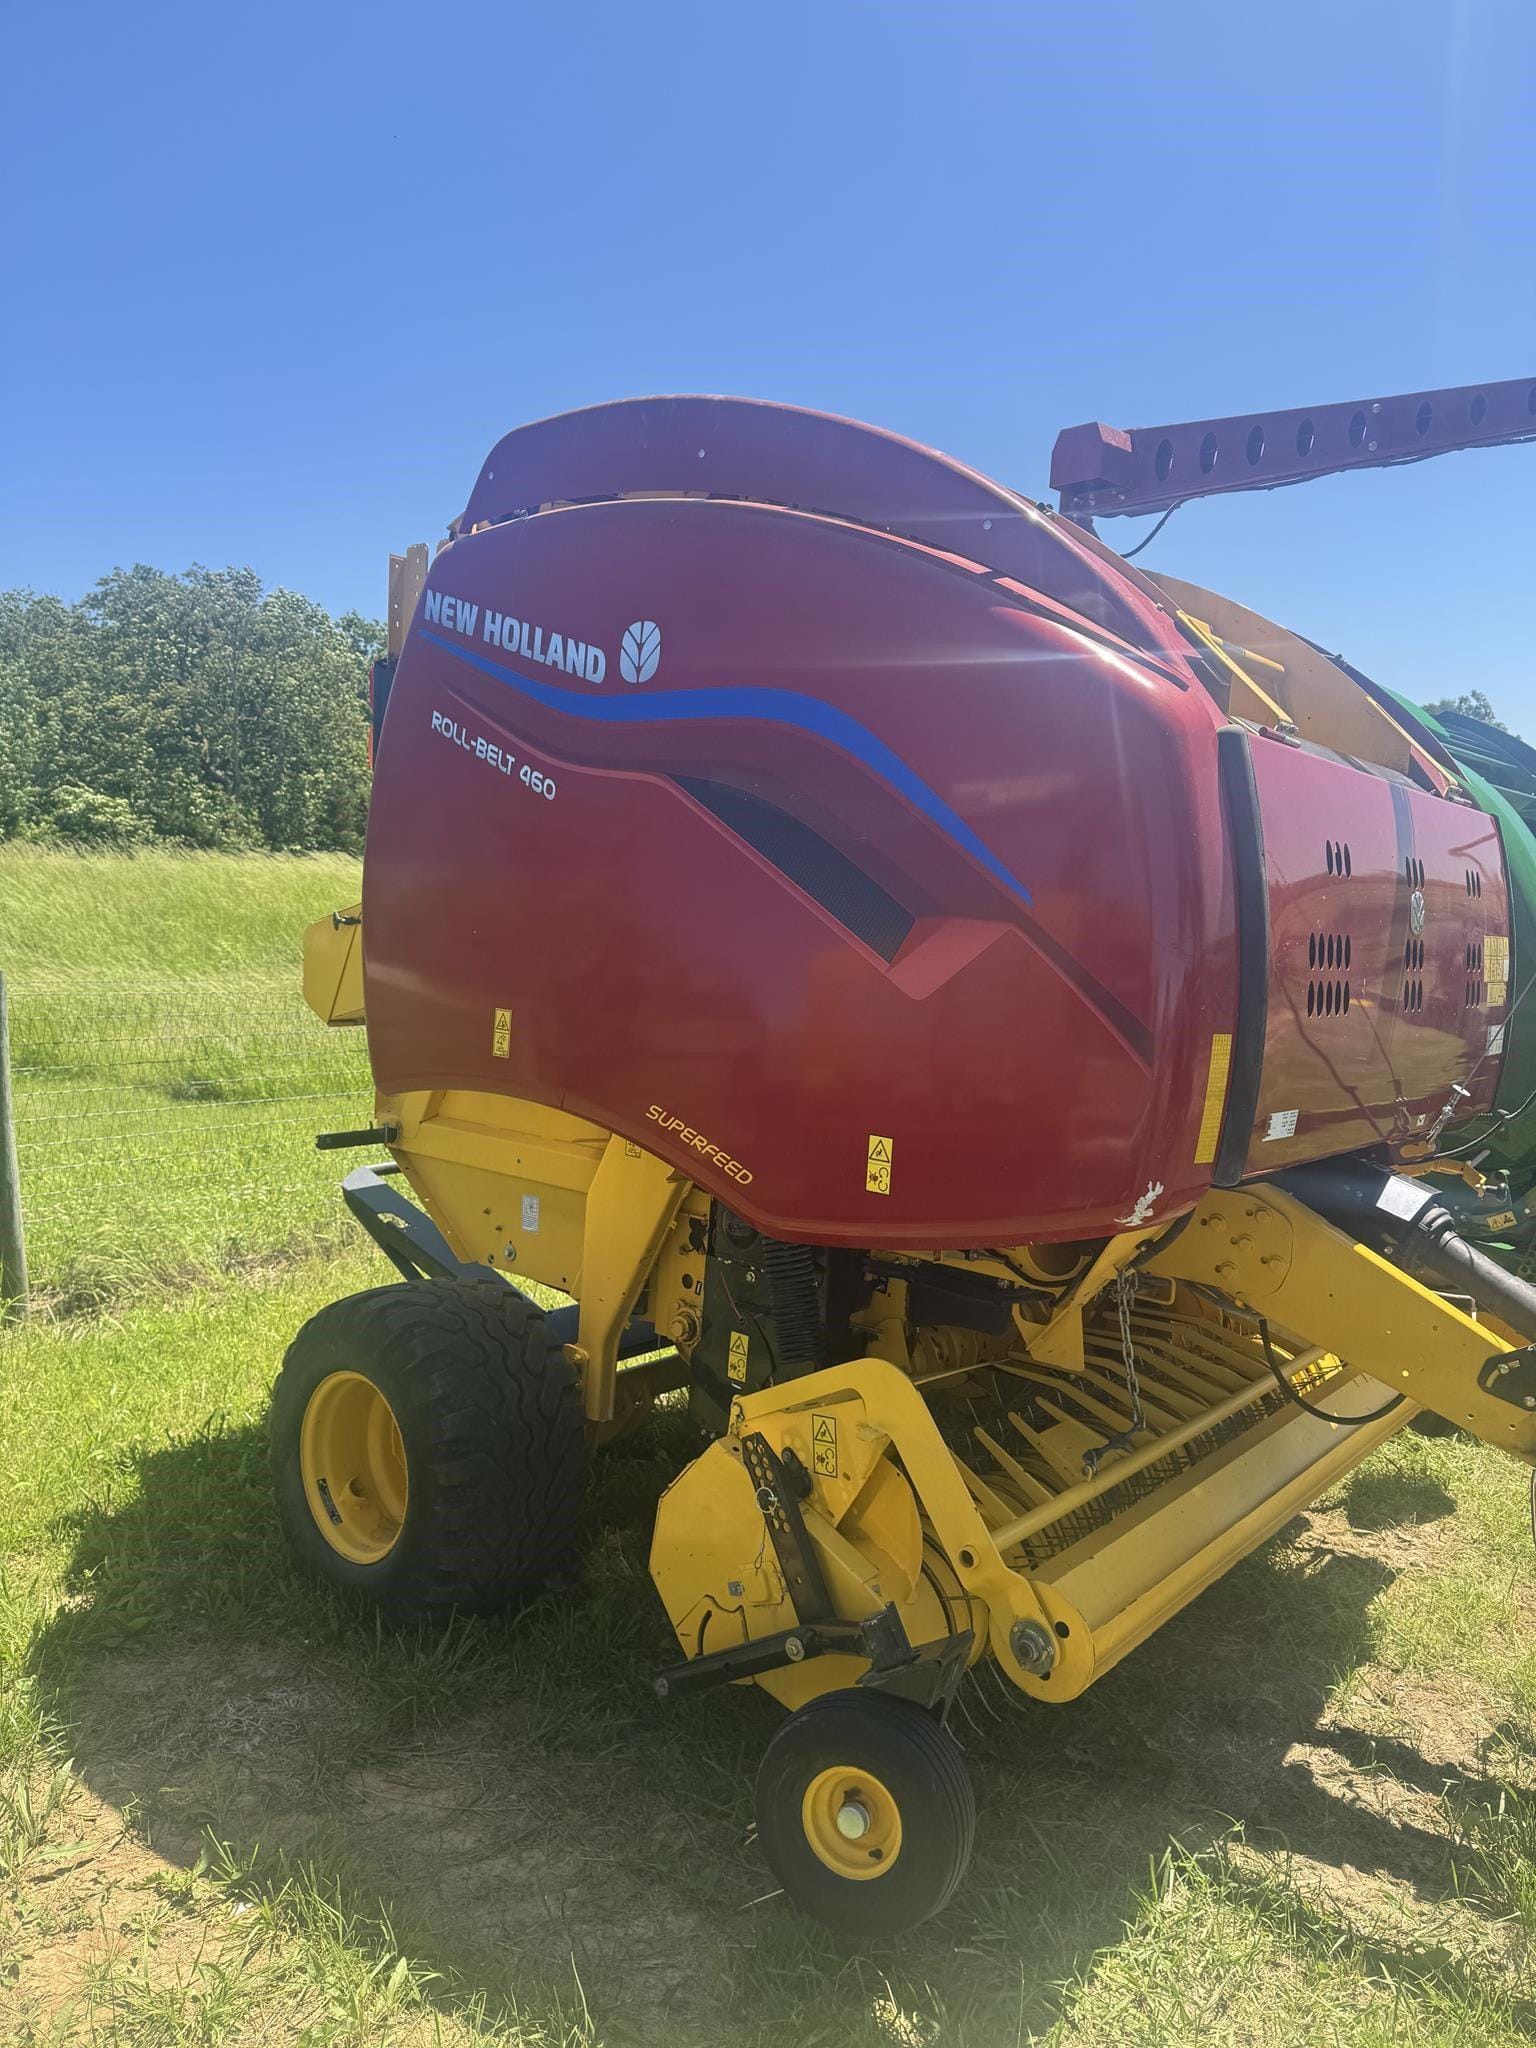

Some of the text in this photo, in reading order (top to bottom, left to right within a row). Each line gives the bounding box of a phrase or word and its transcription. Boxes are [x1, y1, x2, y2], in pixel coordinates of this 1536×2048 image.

[425, 589, 606, 684] NEW HOLLAND
[432, 711, 556, 800] ROLL-BELT 460
[646, 1105, 753, 1184] SUPERFEED
